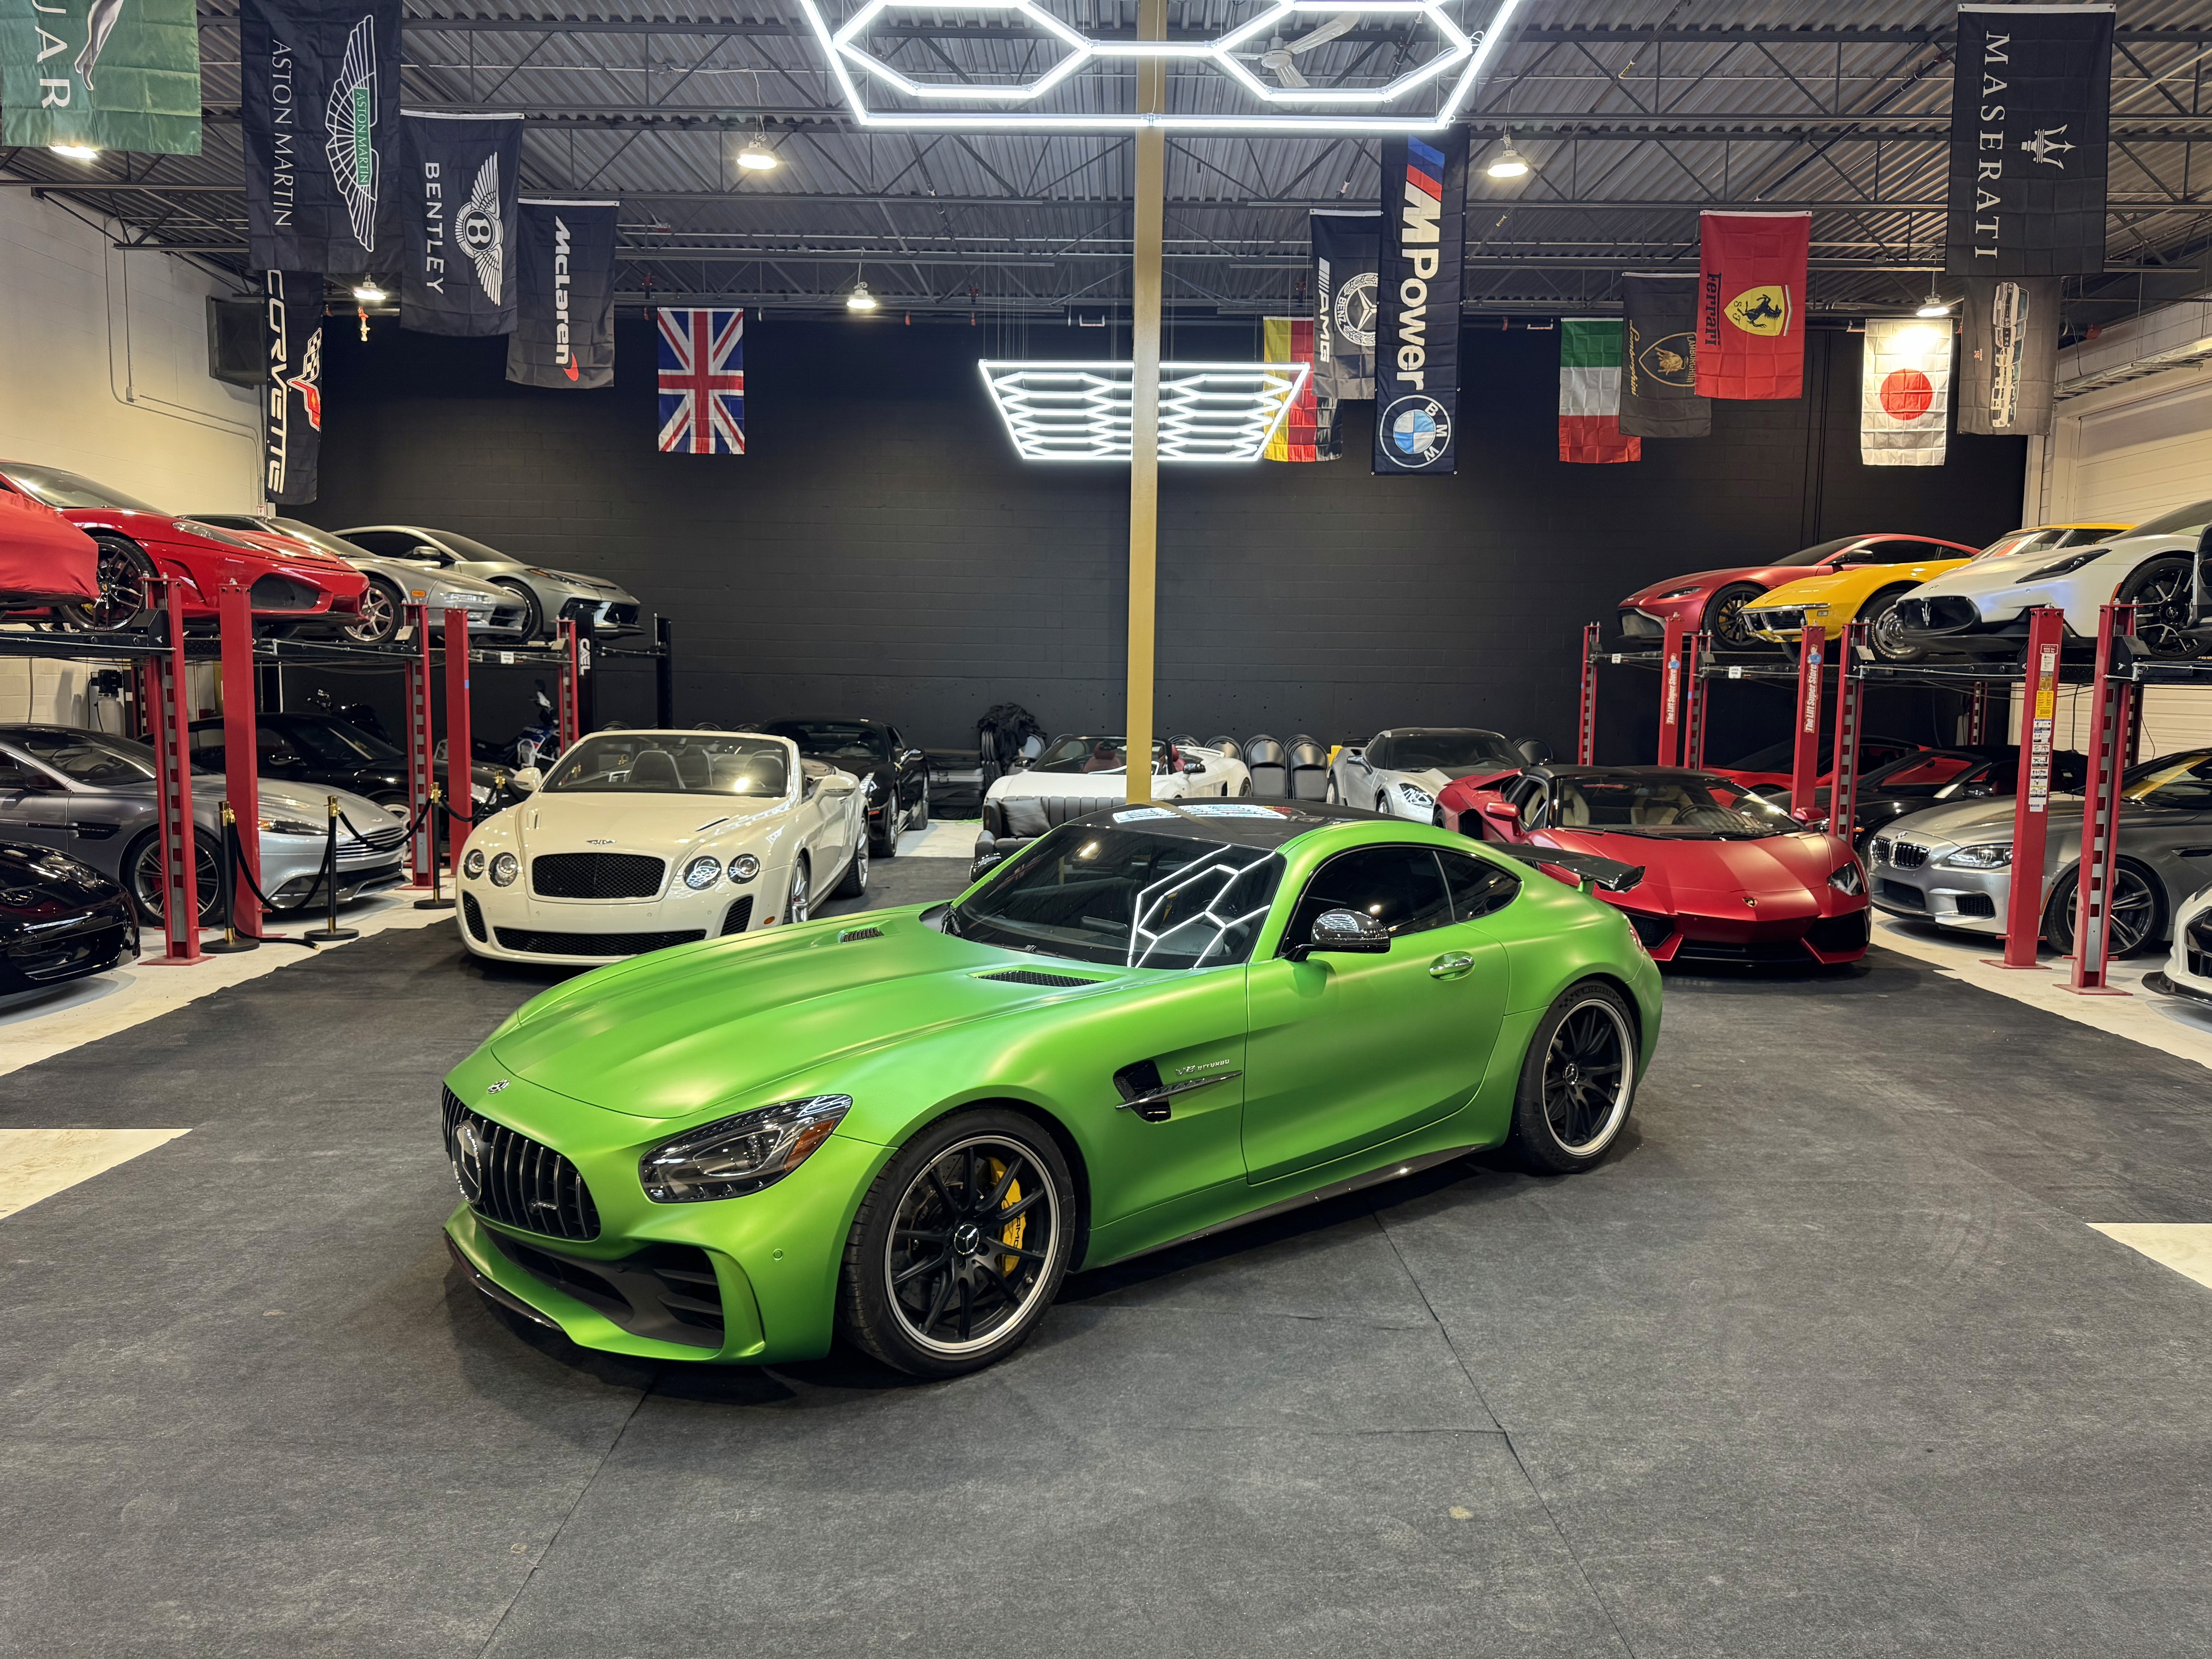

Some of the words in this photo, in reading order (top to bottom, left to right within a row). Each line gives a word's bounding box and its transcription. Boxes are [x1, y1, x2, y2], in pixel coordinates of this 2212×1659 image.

[272, 39, 292, 124] ASTON
[356, 92, 367, 132] ASTON
[357, 136, 368, 183] MARTIN
[1975, 31, 2010, 260] MASERATI
[274, 133, 294, 227] MARTIN
[425, 162, 444, 295] BENTLEY
[1337, 296, 1347, 325] BENZ
[1705, 271, 1722, 346] Ferrari
[1629, 319, 1640, 397] Lamborghini
[1686, 336, 1696, 383] LAMBORGHINI
[267, 270, 287, 494] CORVETTE
[1807, 685, 1817, 706] Super
[1808, 664, 1817, 684] Store
[1805, 719, 1814, 732] The
[1806, 706, 1814, 718] Lift
[1175, 1065, 1195, 1075] V8
[1197, 1059, 1230, 1071] BITURBO
